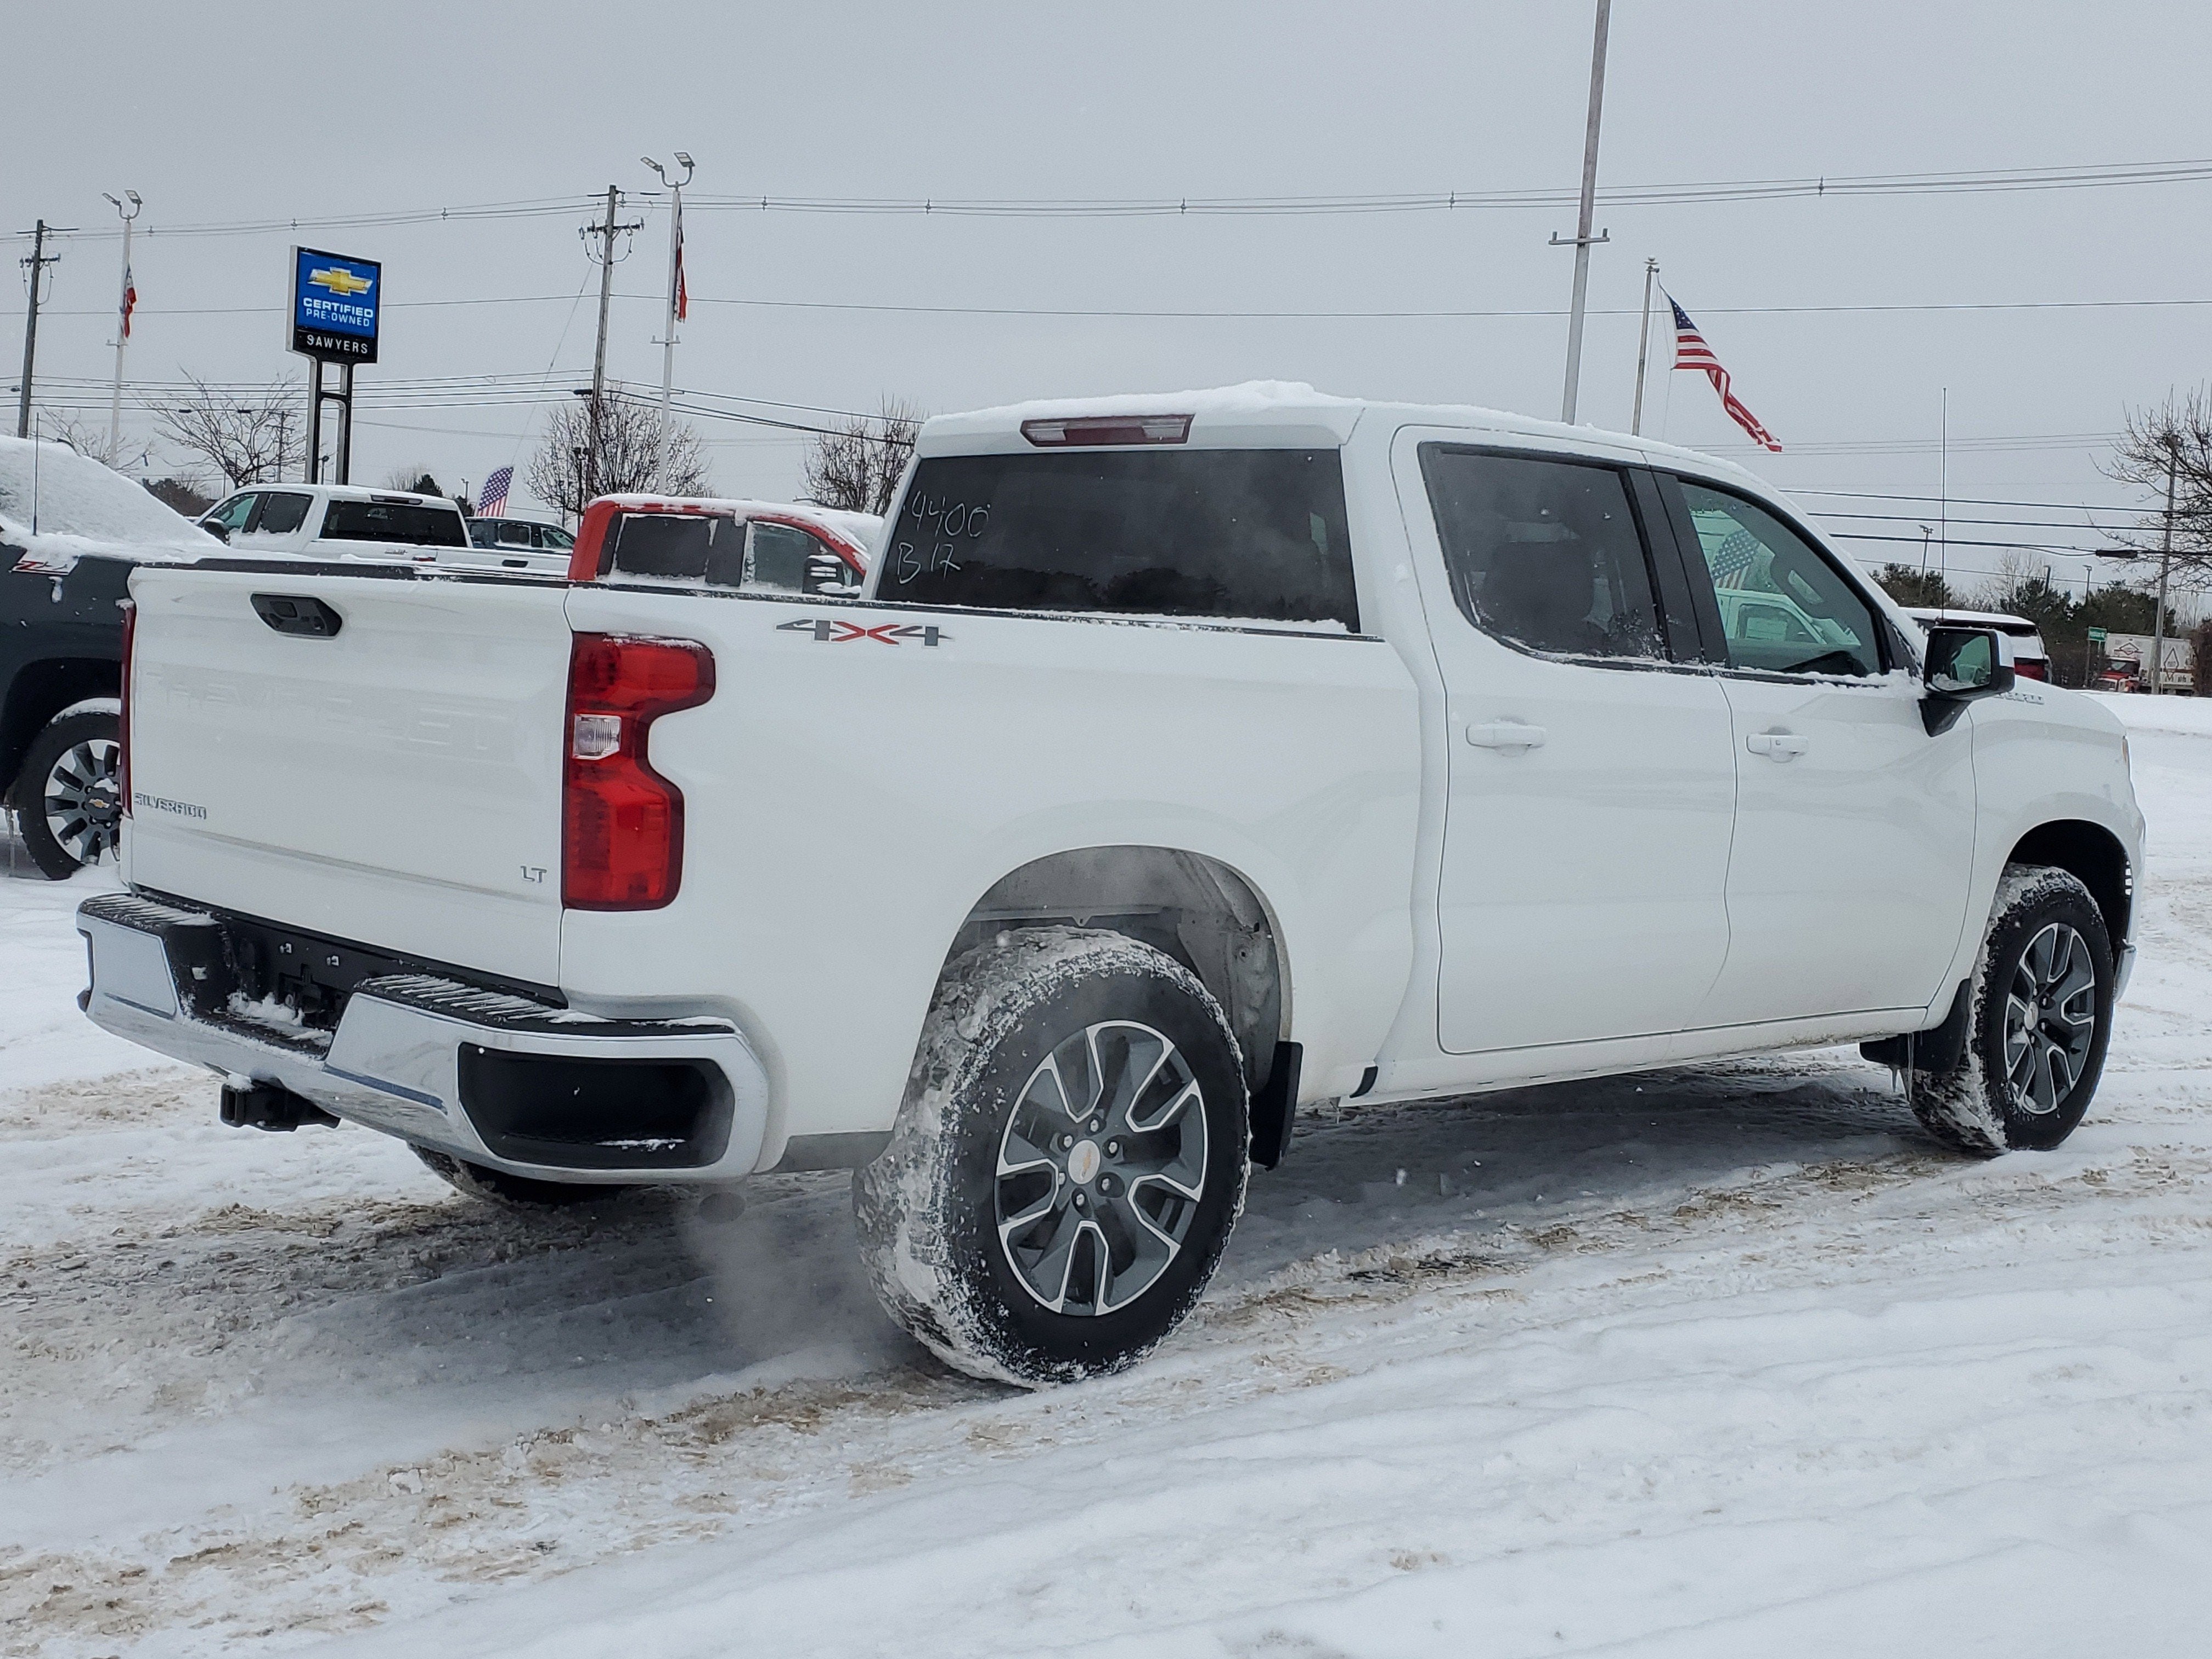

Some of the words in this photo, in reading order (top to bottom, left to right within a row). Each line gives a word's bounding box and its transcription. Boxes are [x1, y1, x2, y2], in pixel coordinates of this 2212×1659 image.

[303, 297, 374, 318] CERTIFIED
[306, 308, 370, 327] PRE-OWNED
[307, 335, 368, 354] SAWYERS
[134, 792, 207, 820] SILVERADO
[520, 866, 547, 883] LT
